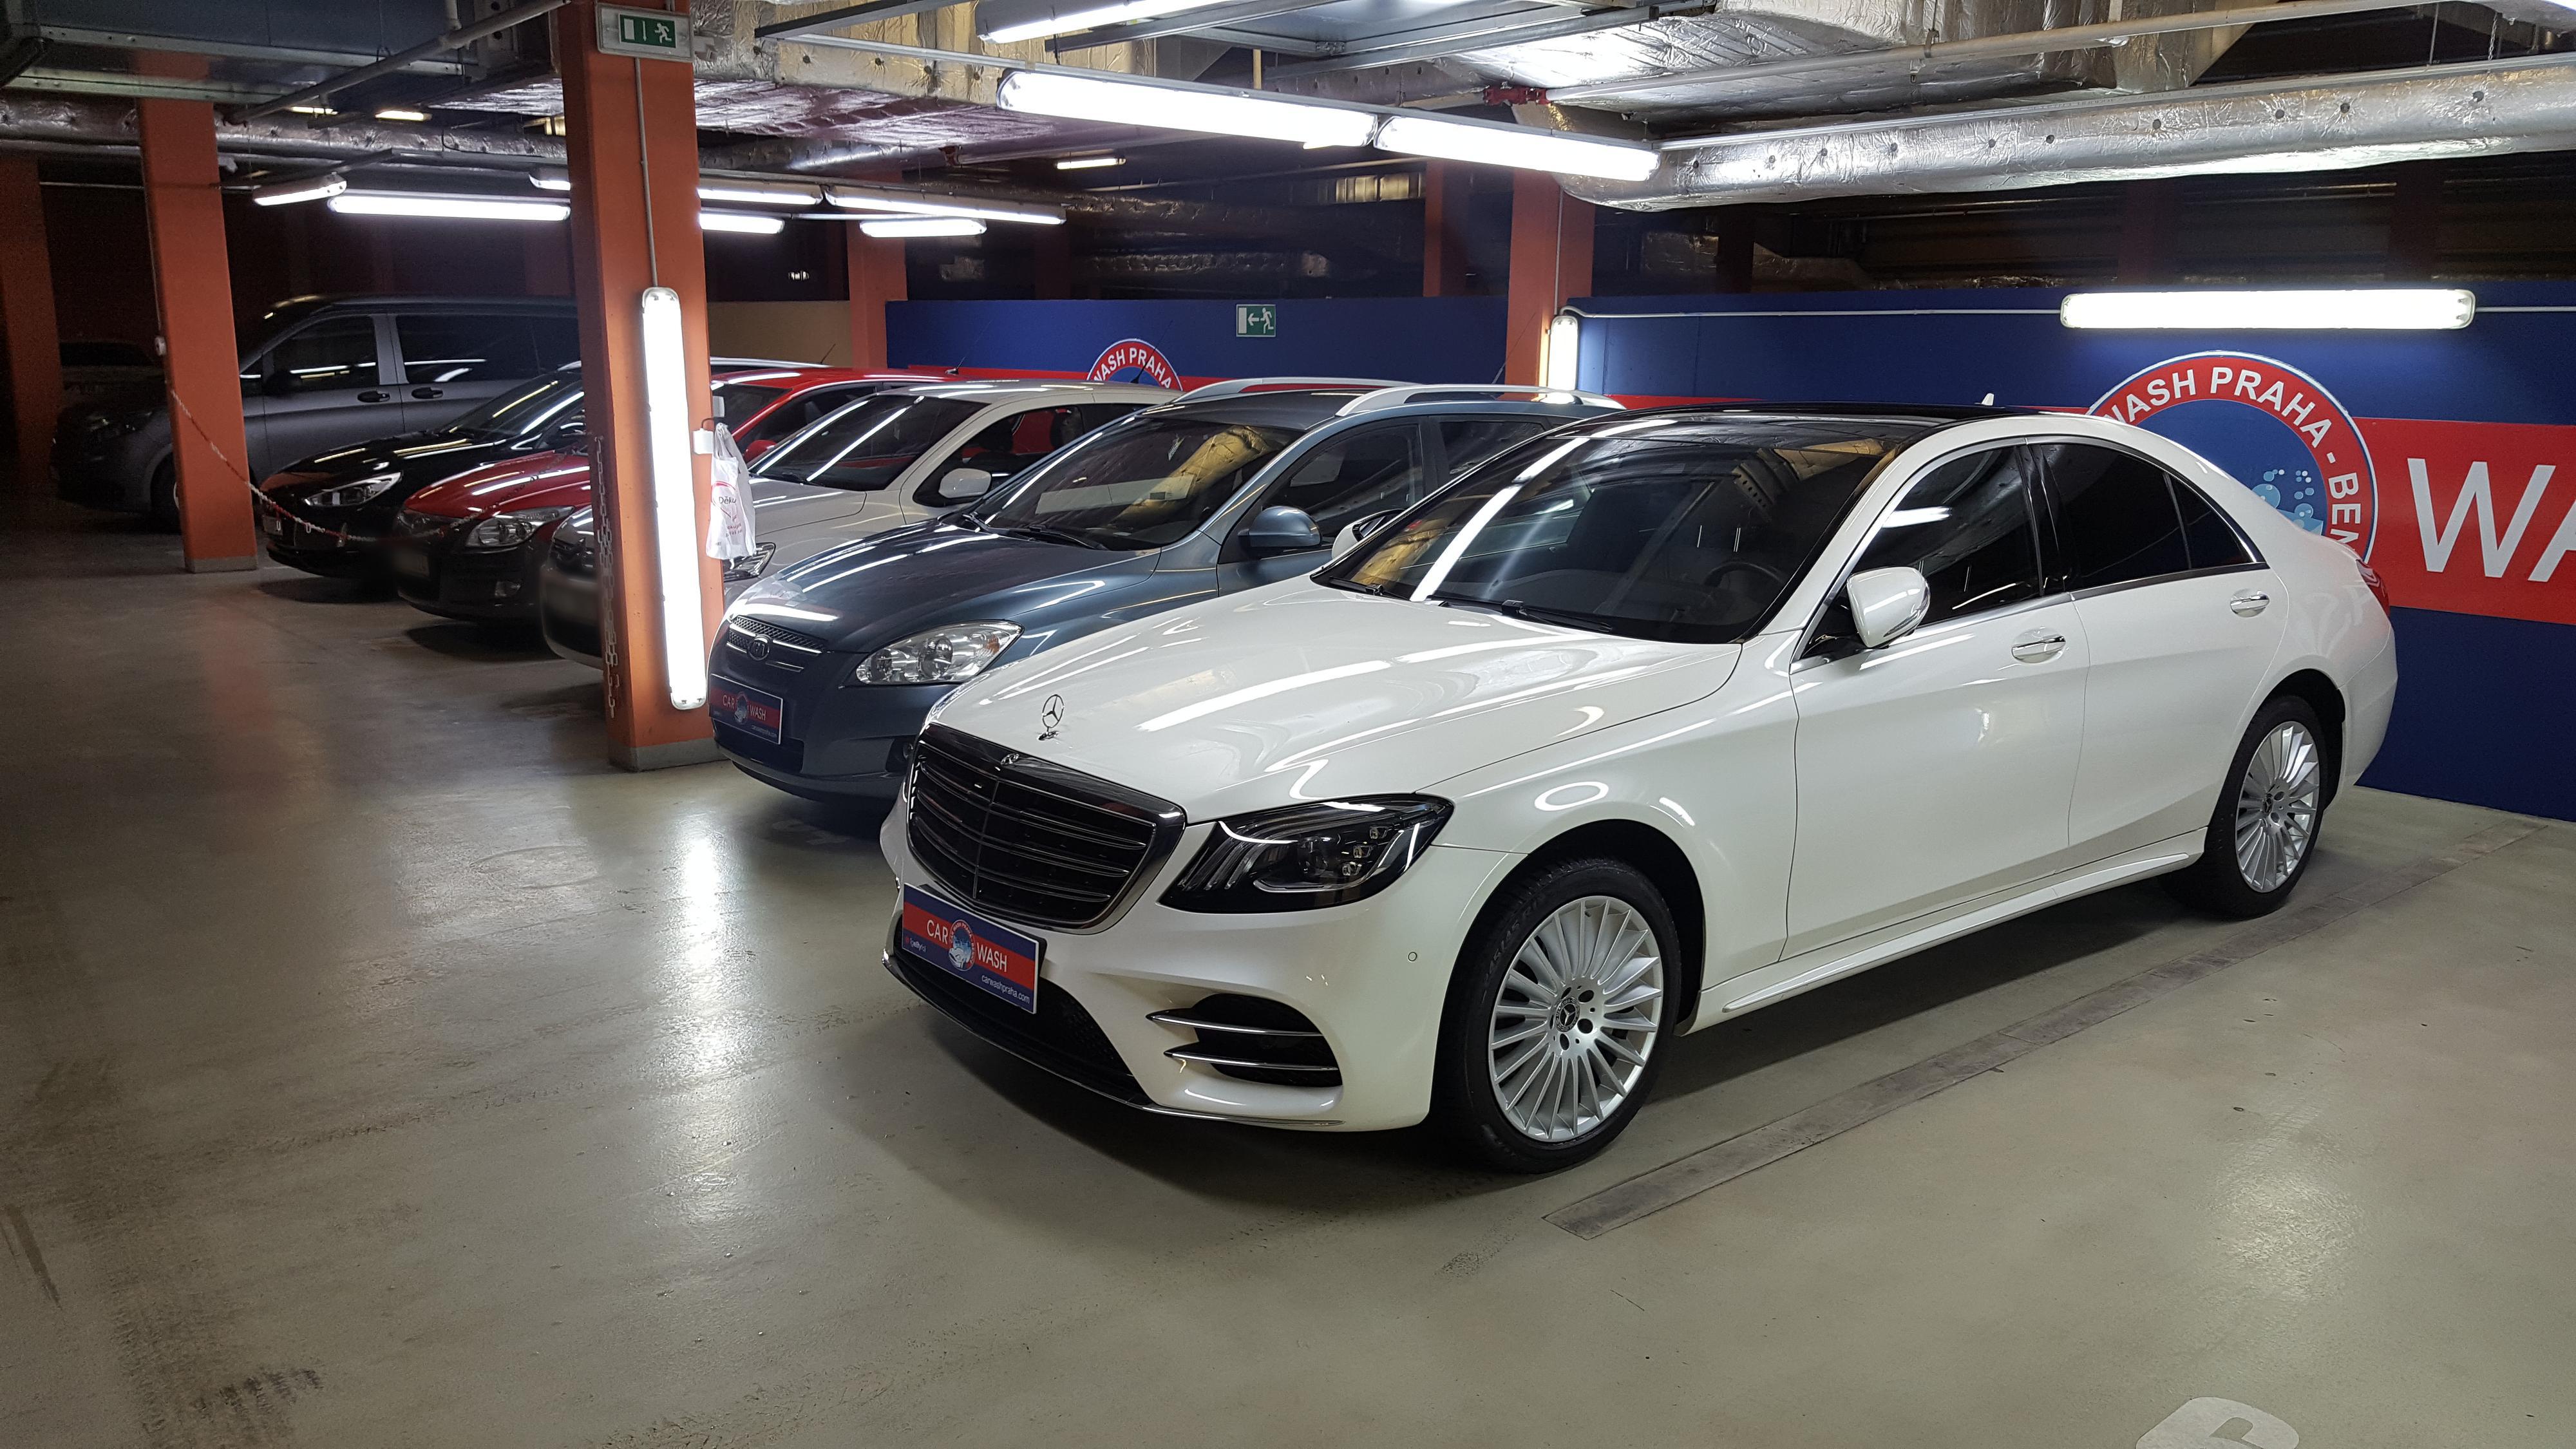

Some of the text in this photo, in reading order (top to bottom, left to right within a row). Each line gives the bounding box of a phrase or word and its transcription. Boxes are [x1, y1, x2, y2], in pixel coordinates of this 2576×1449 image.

[1129, 347, 1172, 389] PRAHA
[2210, 366, 2334, 448] PRAHA
[723, 694, 766, 721] CAR WASH
[927, 919, 949, 945] CAR
[977, 942, 1007, 972] WASH
[981, 974, 1030, 1004] carwashpraha.com
